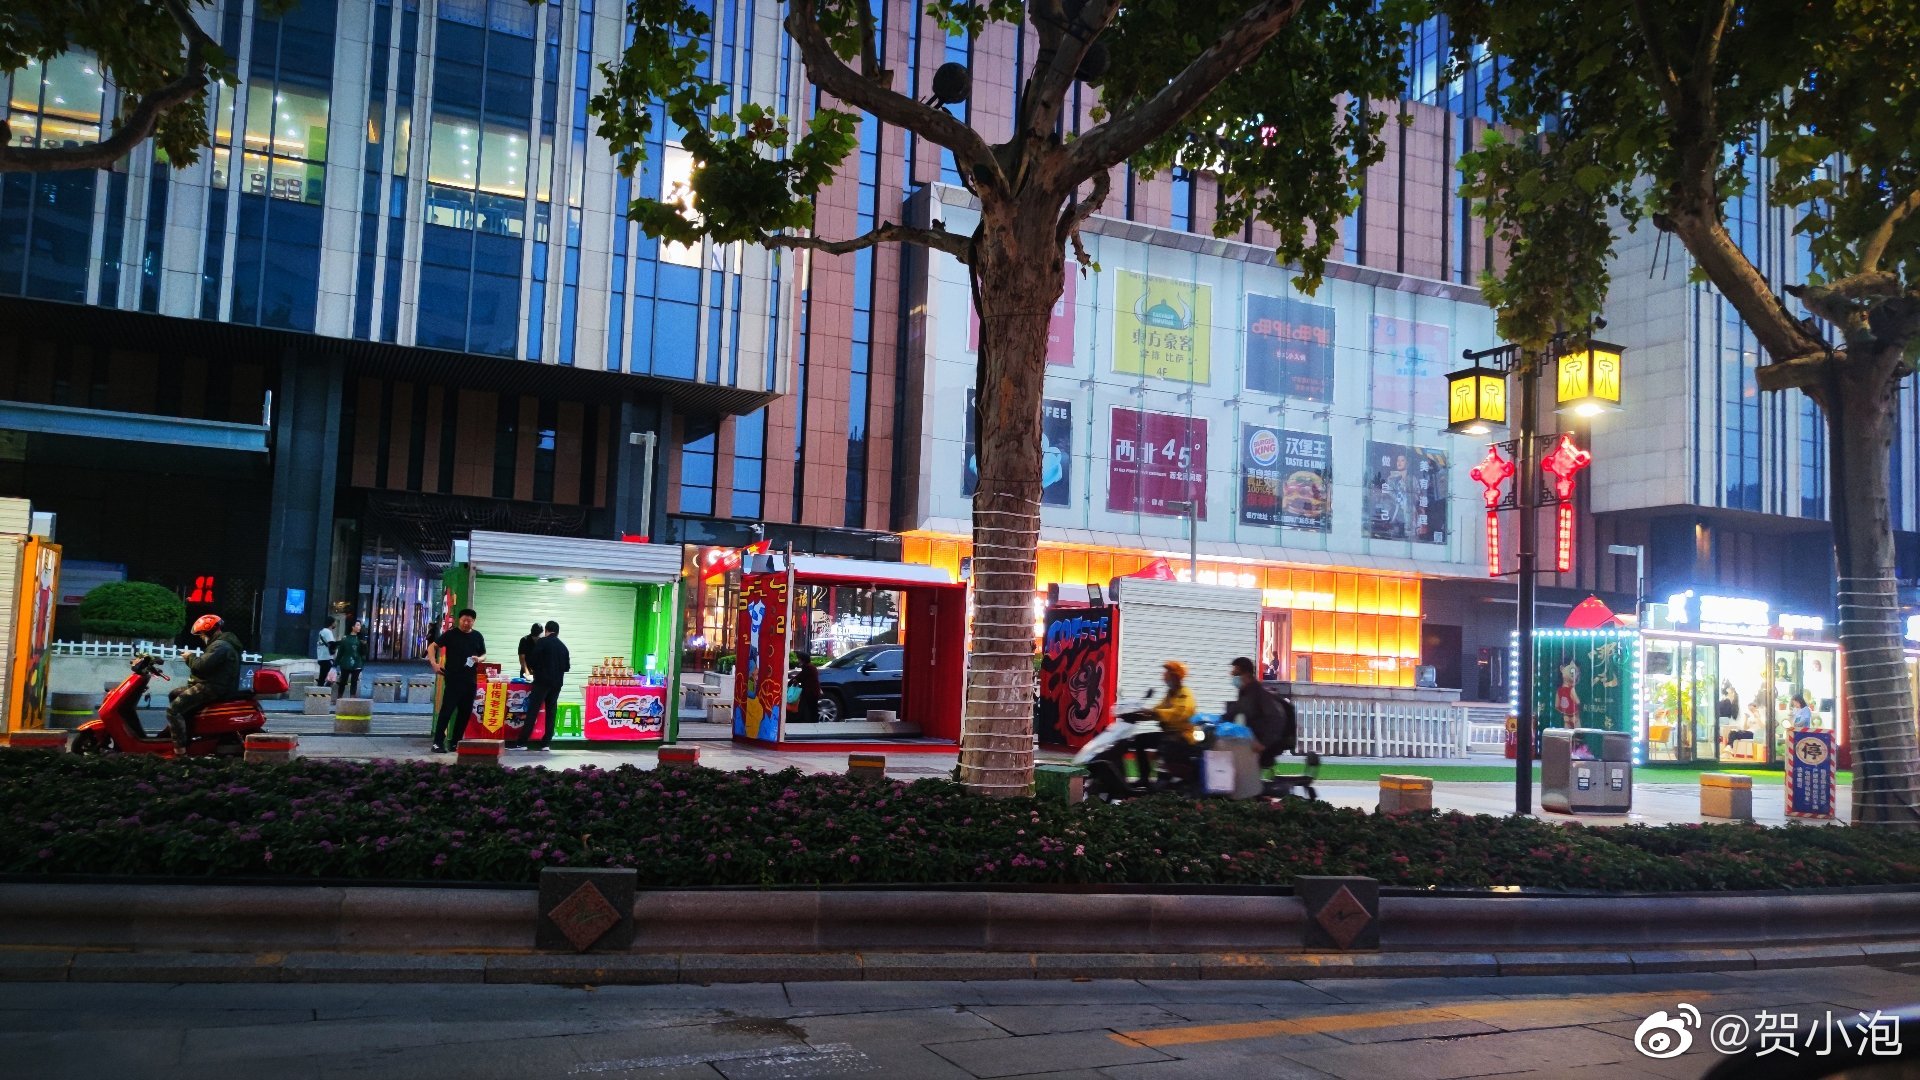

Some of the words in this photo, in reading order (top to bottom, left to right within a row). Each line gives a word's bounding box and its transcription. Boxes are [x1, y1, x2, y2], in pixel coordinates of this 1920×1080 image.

[1156, 367, 1169, 377] 4F
[1254, 443, 1276, 456] KING
[1285, 437, 1326, 459] 汉堡王
[1285, 457, 1303, 468] TASTE
[1802, 742, 1822, 760] 停
